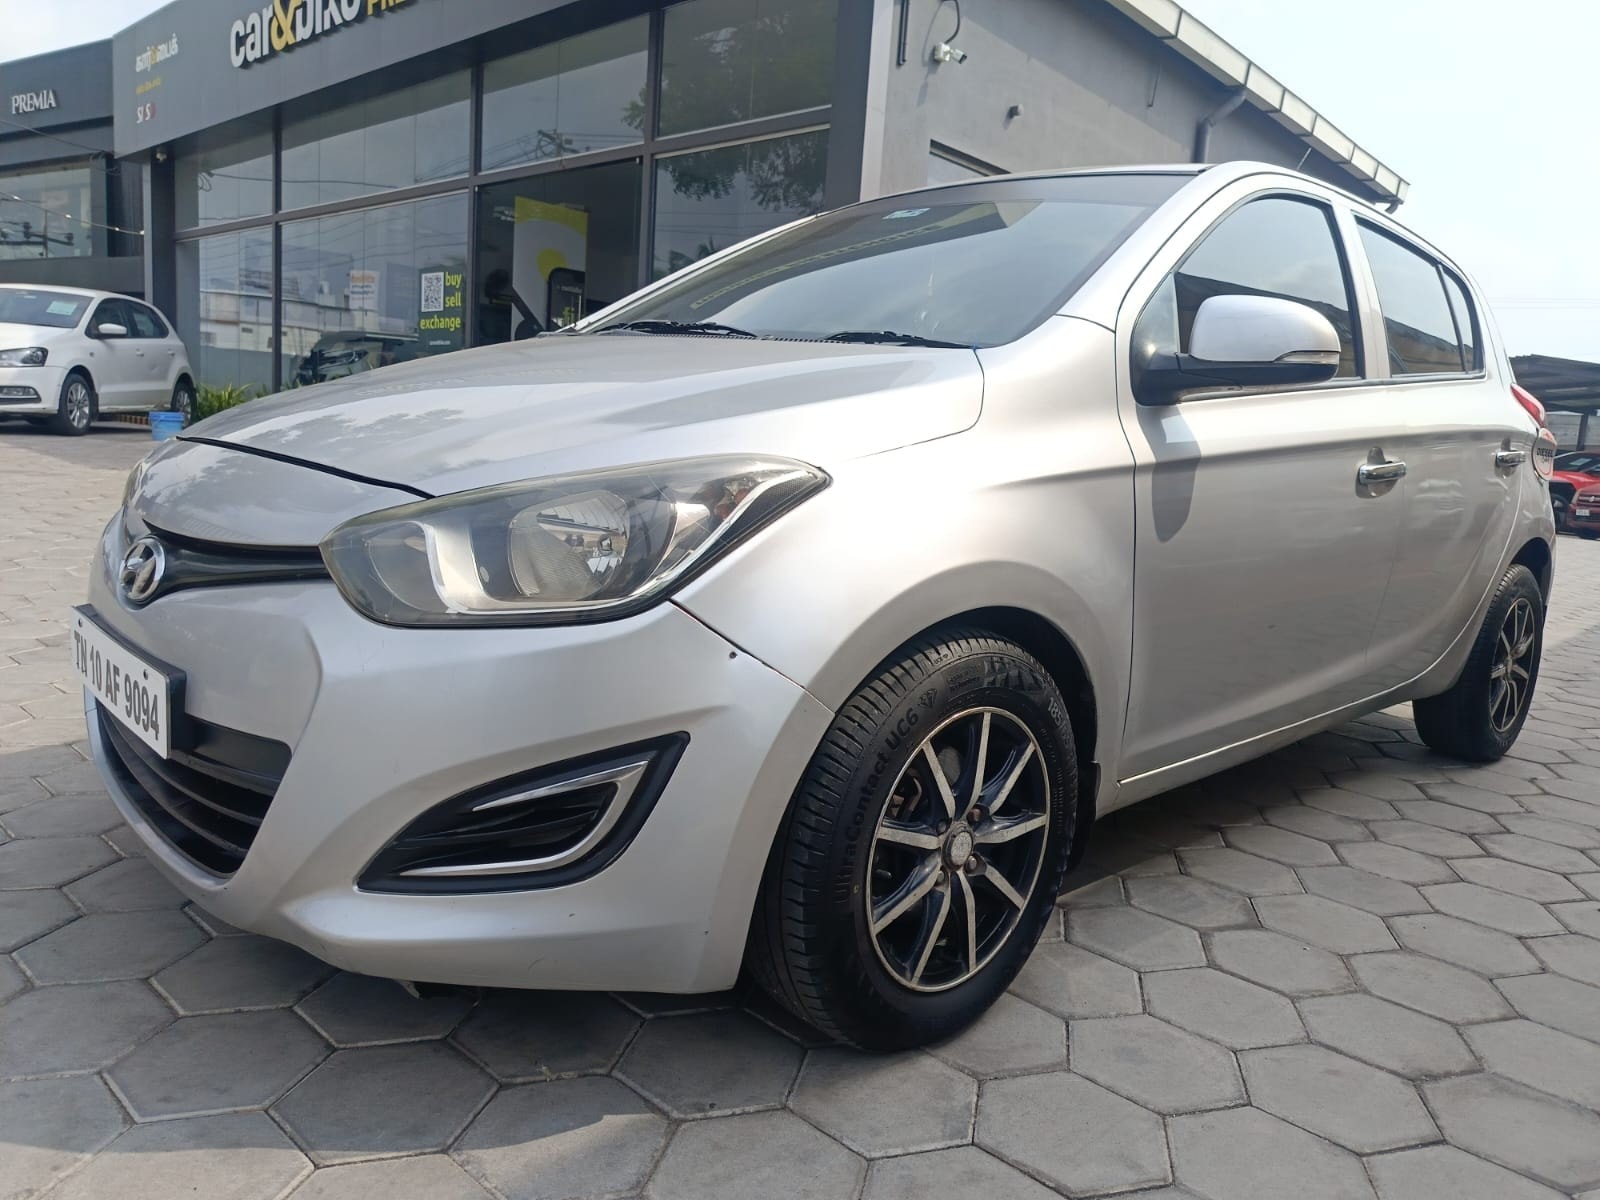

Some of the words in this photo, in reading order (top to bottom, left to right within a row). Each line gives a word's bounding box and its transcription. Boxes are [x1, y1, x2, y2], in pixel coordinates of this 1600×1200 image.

[11, 89, 56, 115] PREMIA
[445, 272, 462, 288] buy
[445, 292, 461, 307] sell
[420, 315, 461, 331] exchange
[74, 630, 87, 678] TN
[90, 645, 102, 692] 10
[105, 659, 120, 706] AF
[124, 673, 160, 741] 9094
[884, 707, 919, 750] UC6
